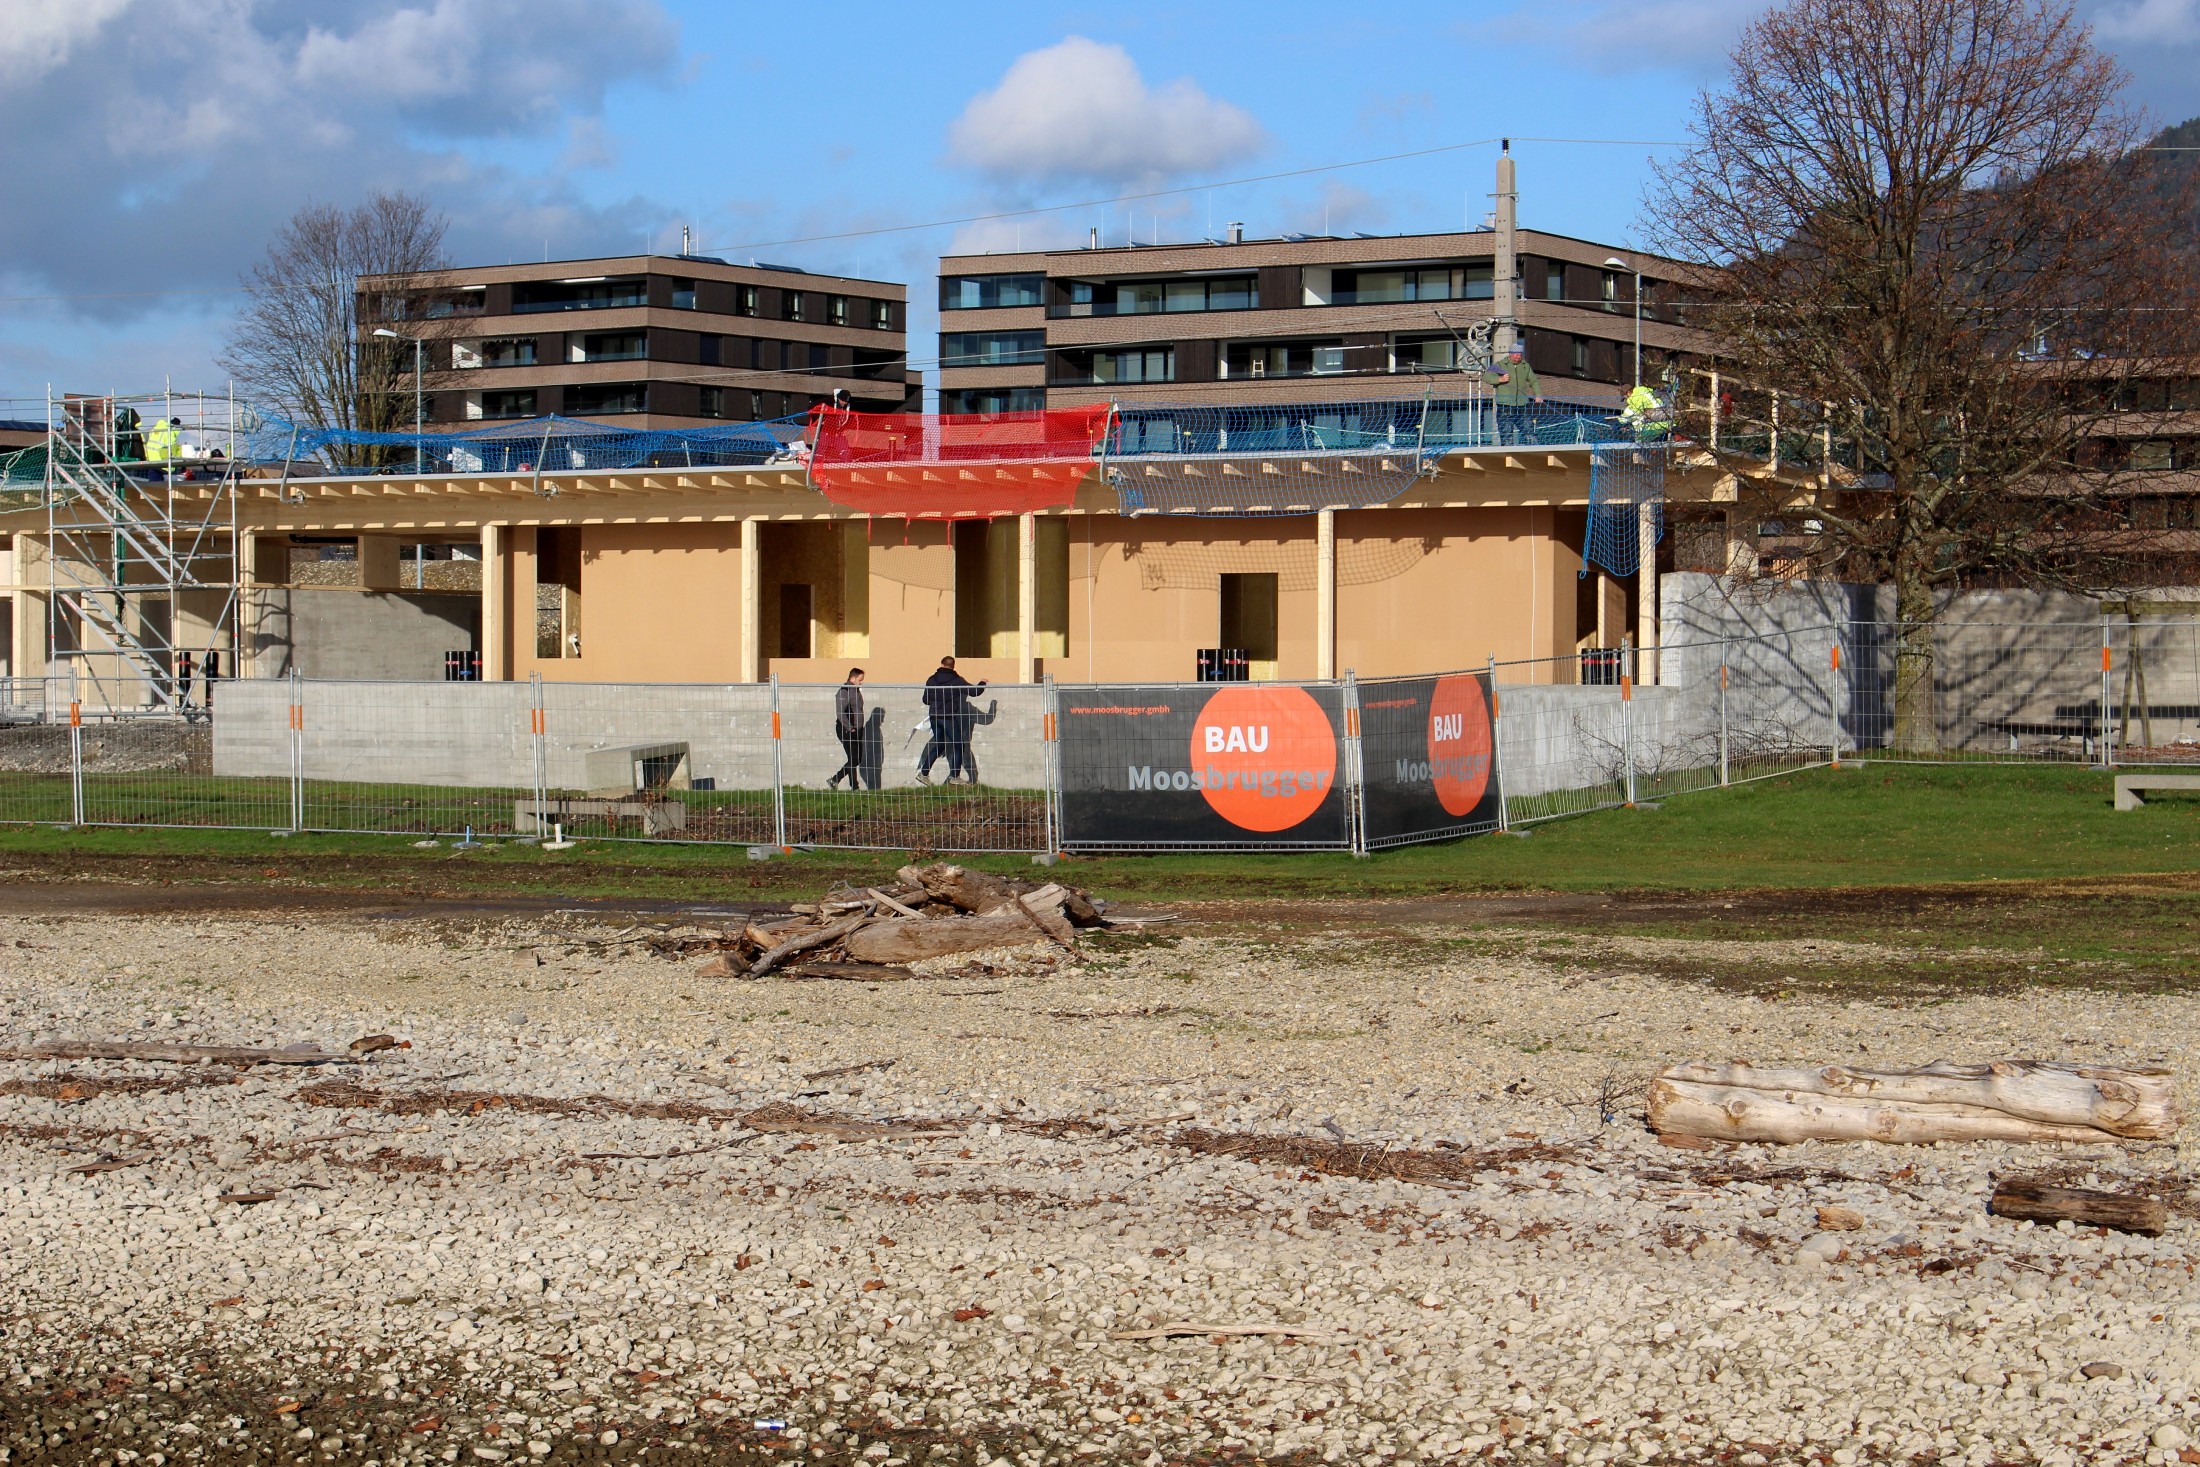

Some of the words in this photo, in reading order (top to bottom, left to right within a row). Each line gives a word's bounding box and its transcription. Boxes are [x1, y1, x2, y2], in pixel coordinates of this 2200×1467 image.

[1070, 705, 1170, 716] www.moosbrugger.gmbh
[1204, 725, 1269, 753] BAU
[1433, 713, 1462, 742] BAU
[1128, 763, 1330, 798] Moosbrugger
[1396, 752, 1488, 784] Moosbrugger
